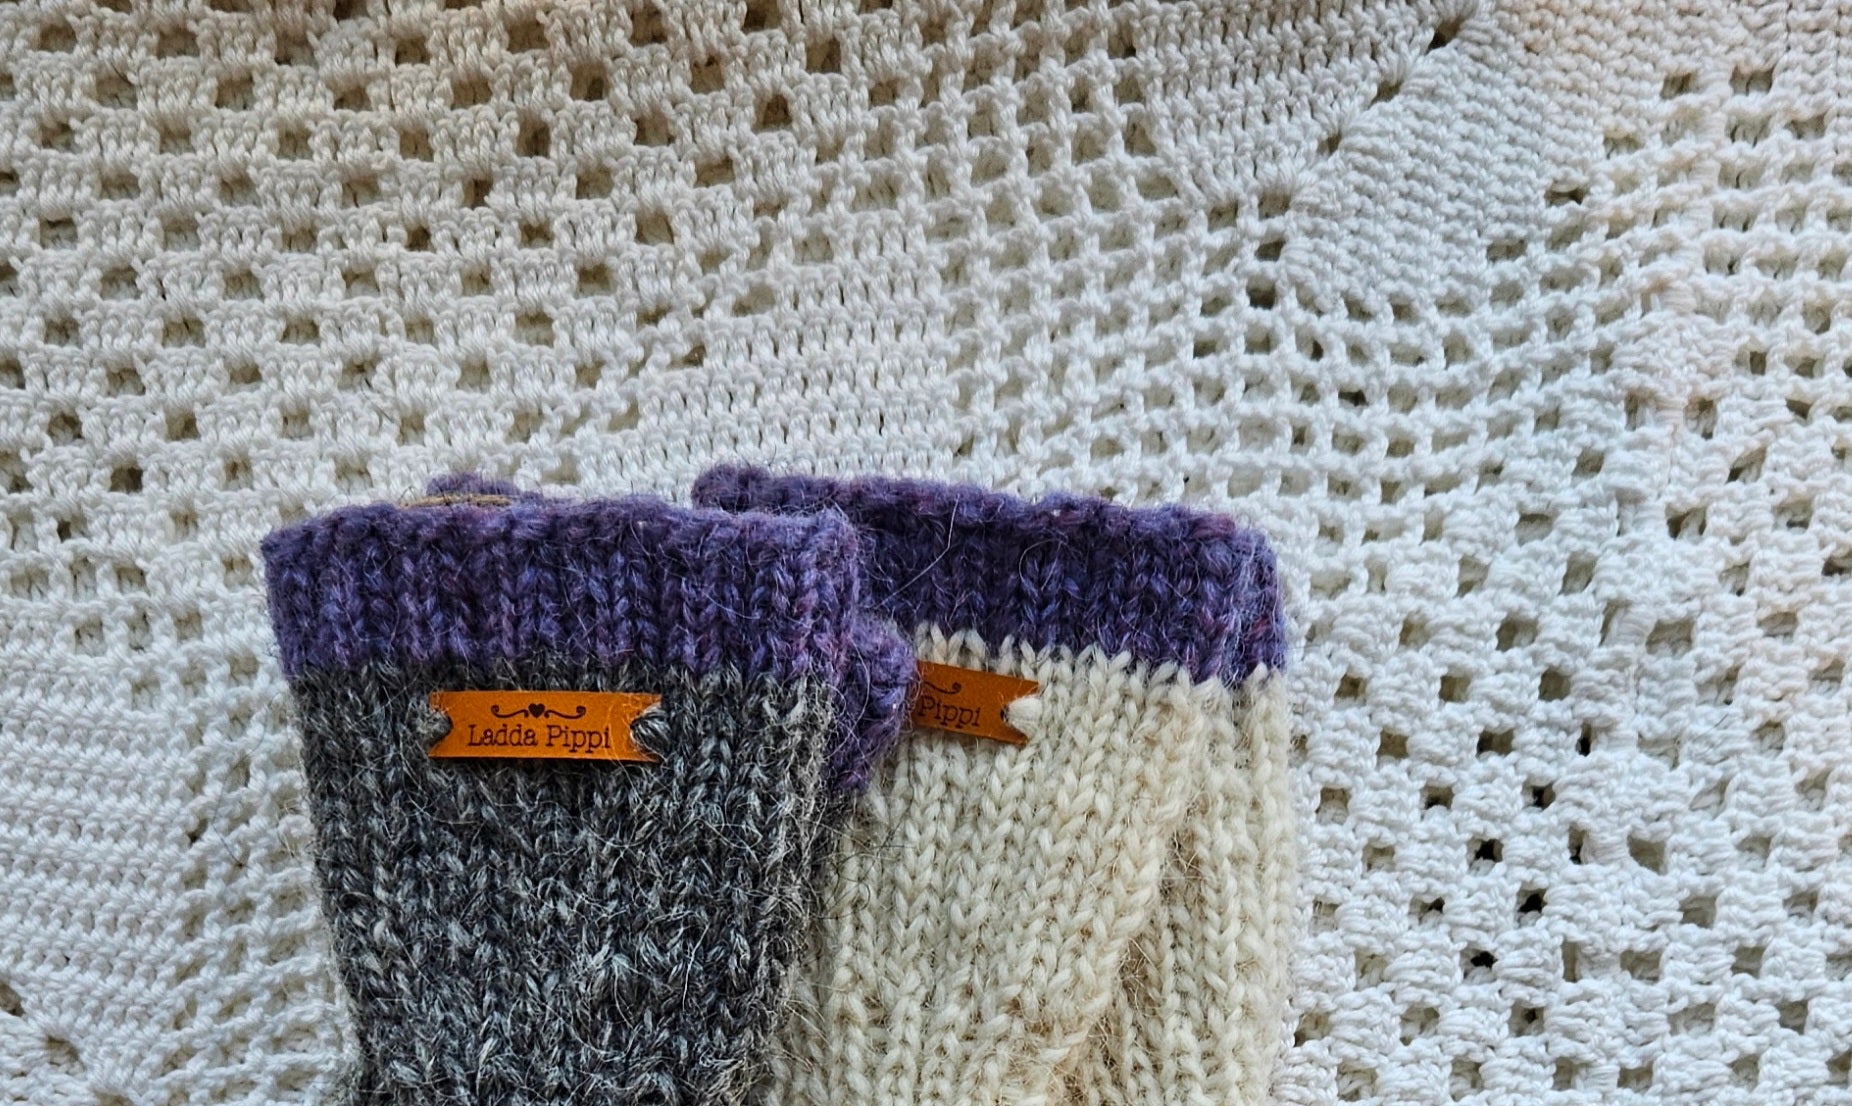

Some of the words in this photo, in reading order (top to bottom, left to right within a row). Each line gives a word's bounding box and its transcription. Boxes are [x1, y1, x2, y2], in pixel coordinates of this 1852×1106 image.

[917, 695, 981, 729] Pippi
[467, 724, 538, 747] Ladda
[545, 724, 611, 754] Pippi
